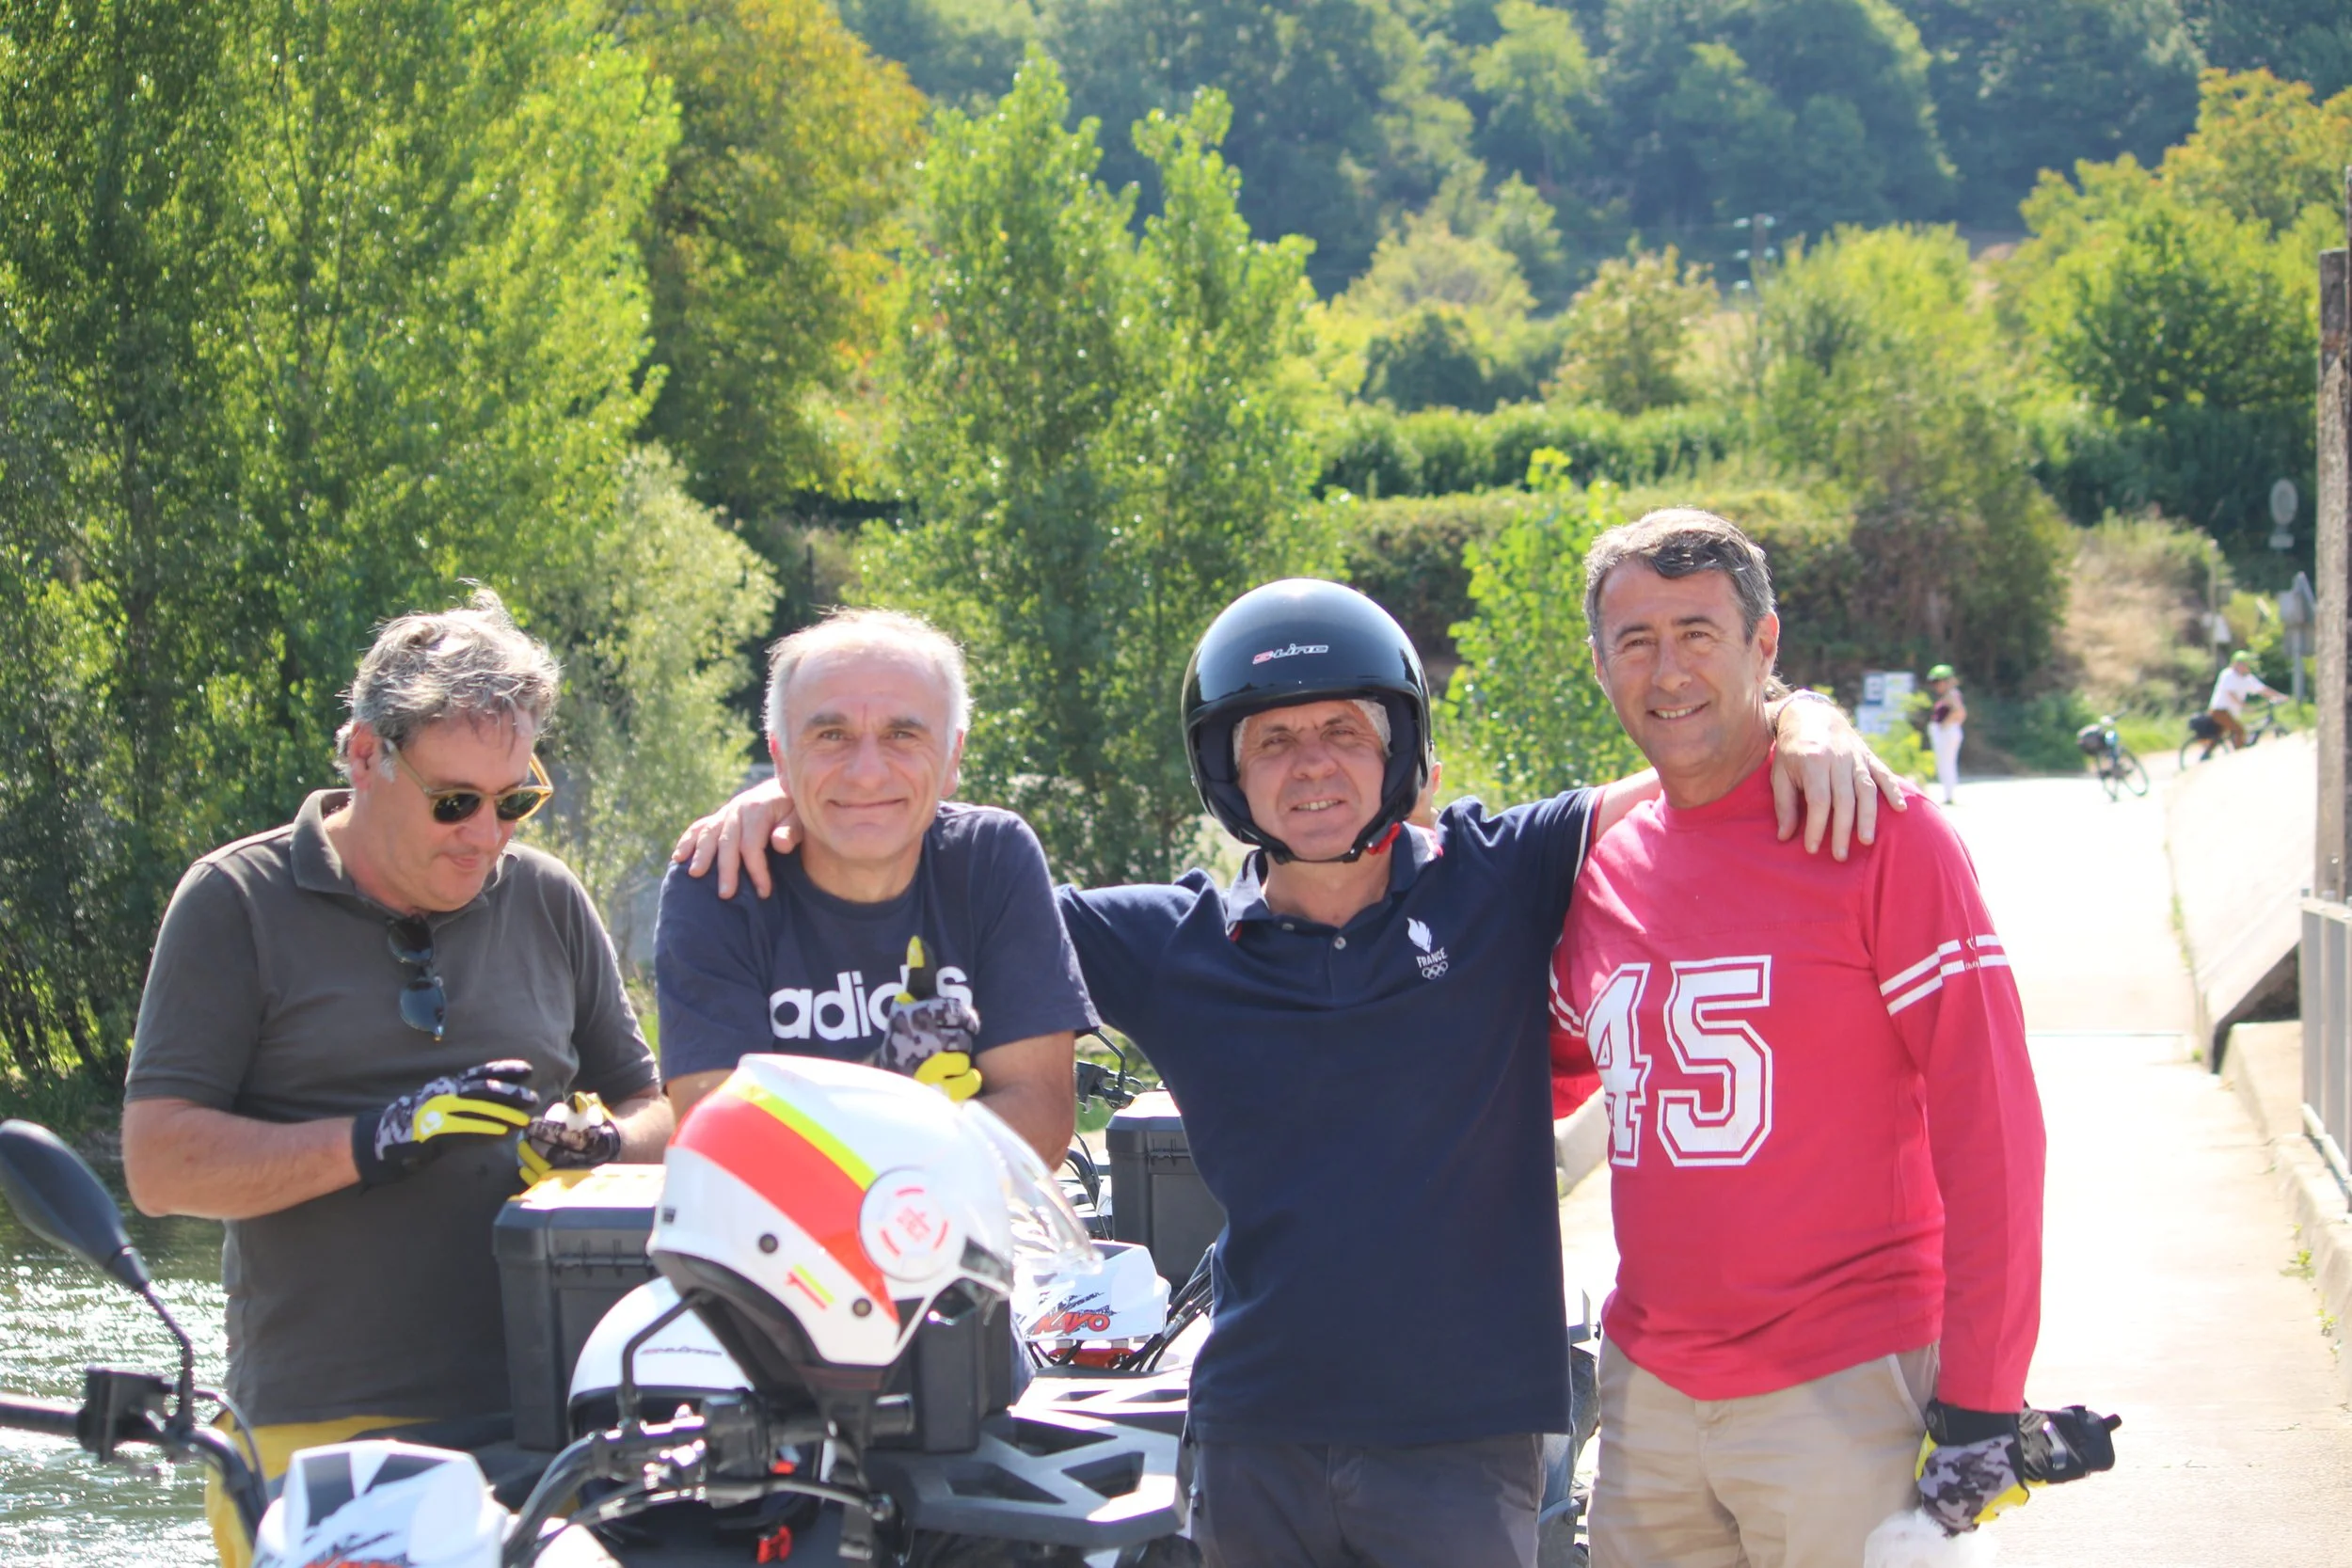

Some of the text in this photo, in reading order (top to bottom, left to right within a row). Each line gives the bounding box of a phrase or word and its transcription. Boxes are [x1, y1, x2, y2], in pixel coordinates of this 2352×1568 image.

[1416, 946, 1448, 968] FRANCE
[770, 965, 973, 1040] adids
[1583, 955, 1772, 1167] 45
